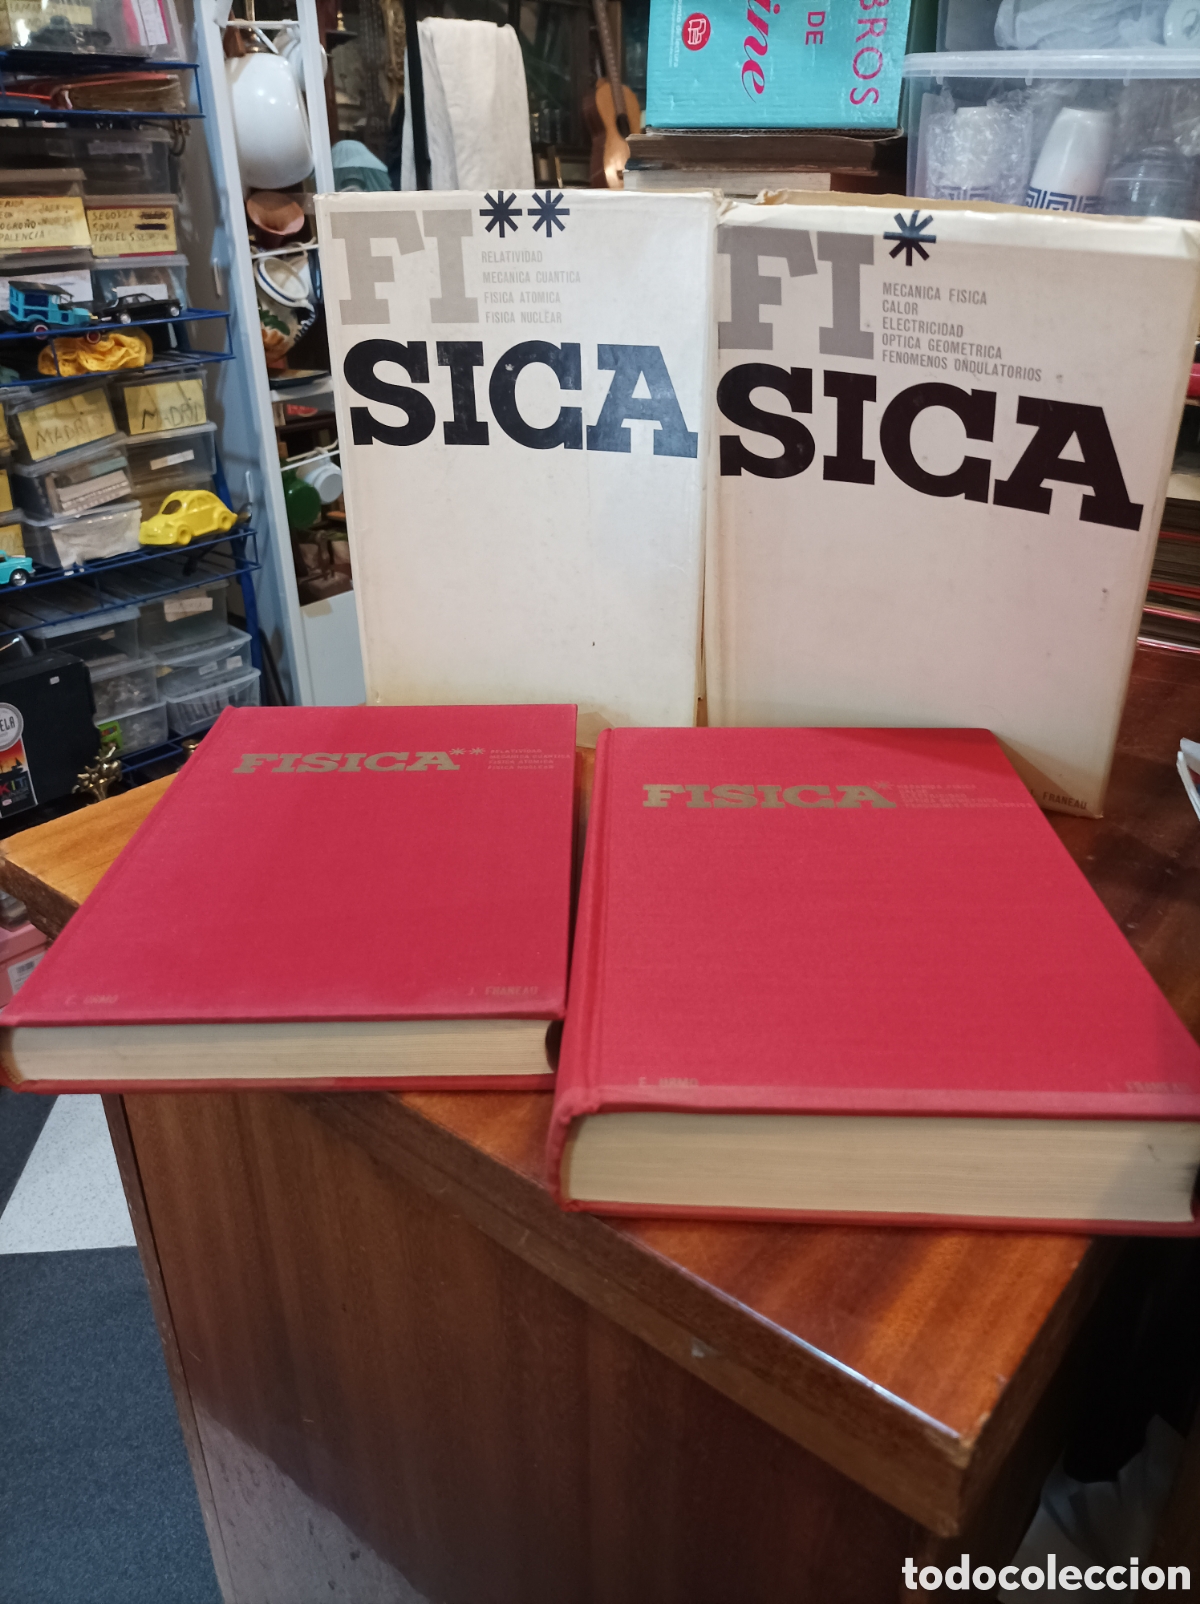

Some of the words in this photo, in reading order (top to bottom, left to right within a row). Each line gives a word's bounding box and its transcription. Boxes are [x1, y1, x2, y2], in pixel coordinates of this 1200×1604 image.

[805, 11, 826, 46] DE
[330, 209, 479, 325] FI
[481, 250, 543, 264] RELATIVIDAD
[482, 270, 531, 284] MECANICA
[535, 270, 581, 284] CUANTICA
[484, 291, 515, 304] FISICA
[519, 291, 562, 304] ATOMICA
[716, 224, 875, 360] FI
[882, 281, 942, 301] MECANICA
[949, 288, 988, 306] FISICA
[485, 311, 516, 324] FISICA
[520, 311, 563, 324] NUCLEAR
[882, 299, 919, 316] CALOR
[882, 316, 964, 338] ELECTRICIDAD
[882, 332, 923, 351] OPTICA
[927, 338, 1003, 360] GEOMETRICA
[882, 349, 948, 370] FENOMENOS
[954, 357, 1042, 382] ONDULATORIOS
[343, 338, 699, 459] SICA
[716, 361, 1145, 532] SICA
[642, 783, 898, 809] FISICA
[1042, 791, 1088, 810] FRANEAU
